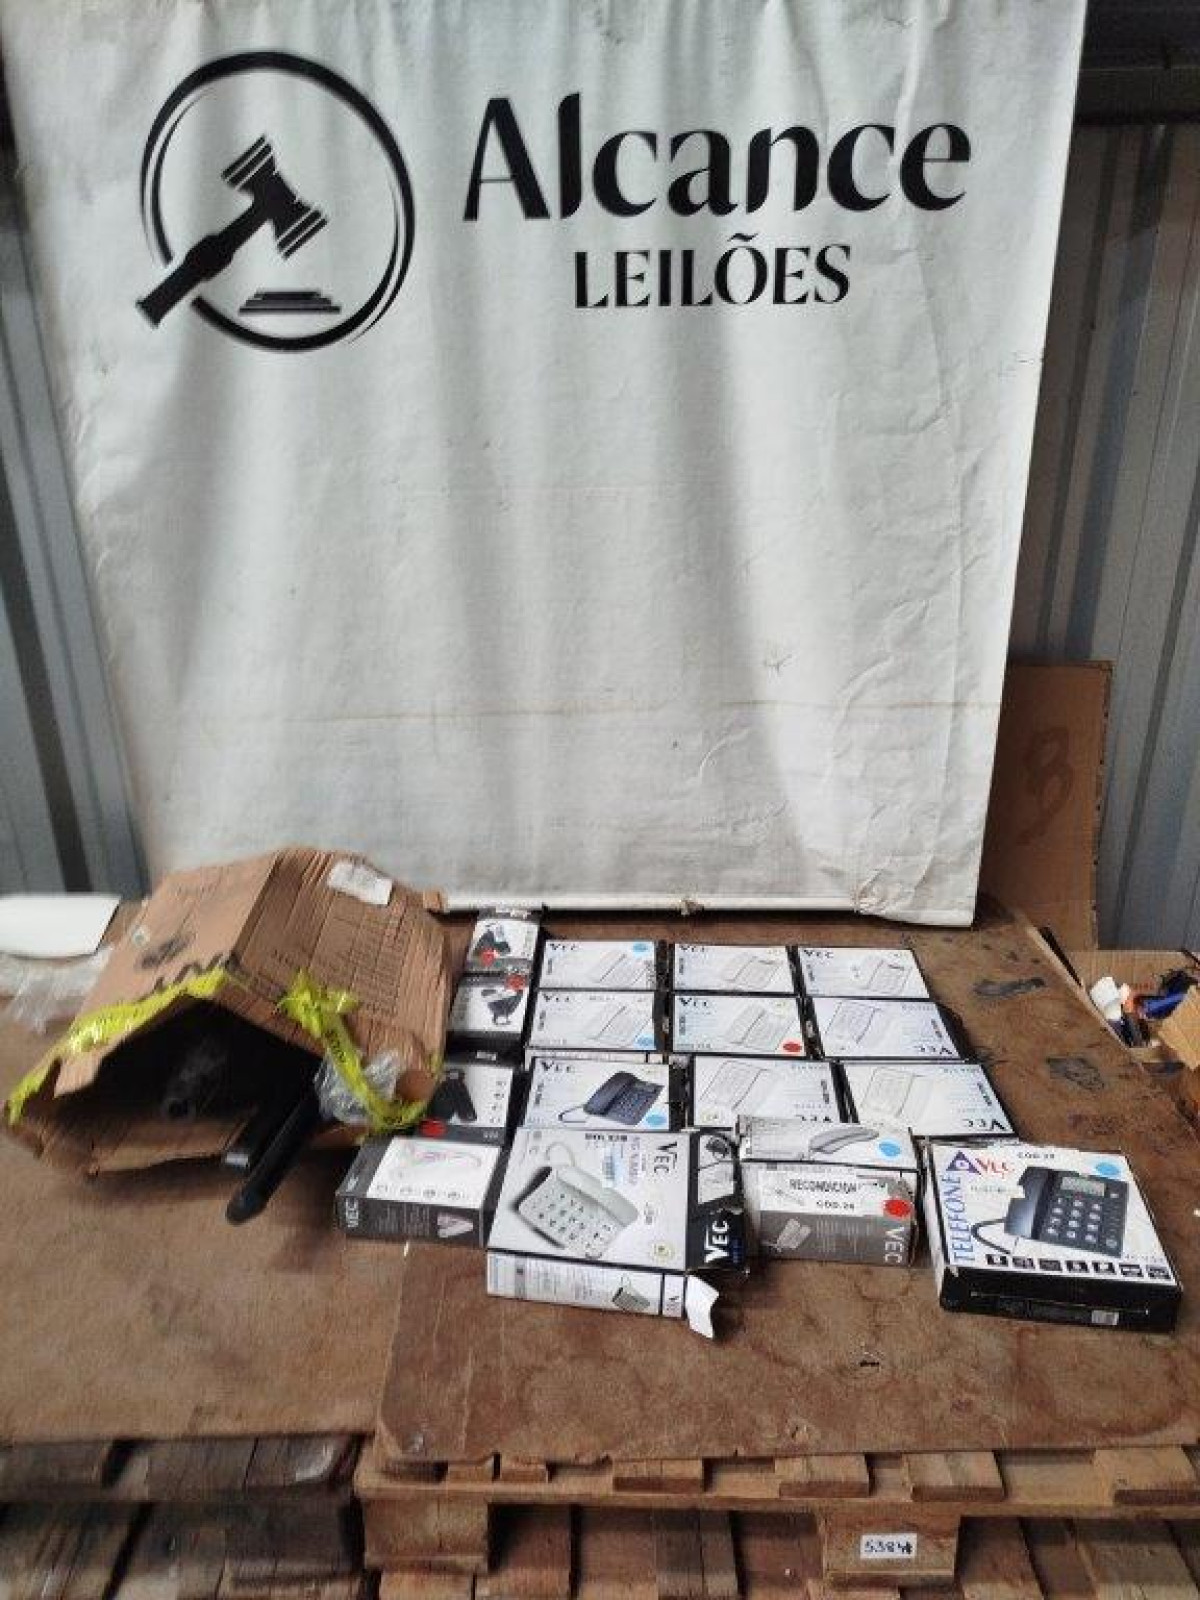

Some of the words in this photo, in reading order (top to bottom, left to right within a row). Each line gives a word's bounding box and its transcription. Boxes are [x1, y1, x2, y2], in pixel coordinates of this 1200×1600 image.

[463, 91, 972, 222] Alcance
[574, 233, 852, 310] LEILÕES
[653, 1141, 678, 1183] VEC
[704, 1220, 730, 1264] VEC
[884, 1227, 904, 1264] VEC
[941, 1174, 977, 1263] TELEFONE
